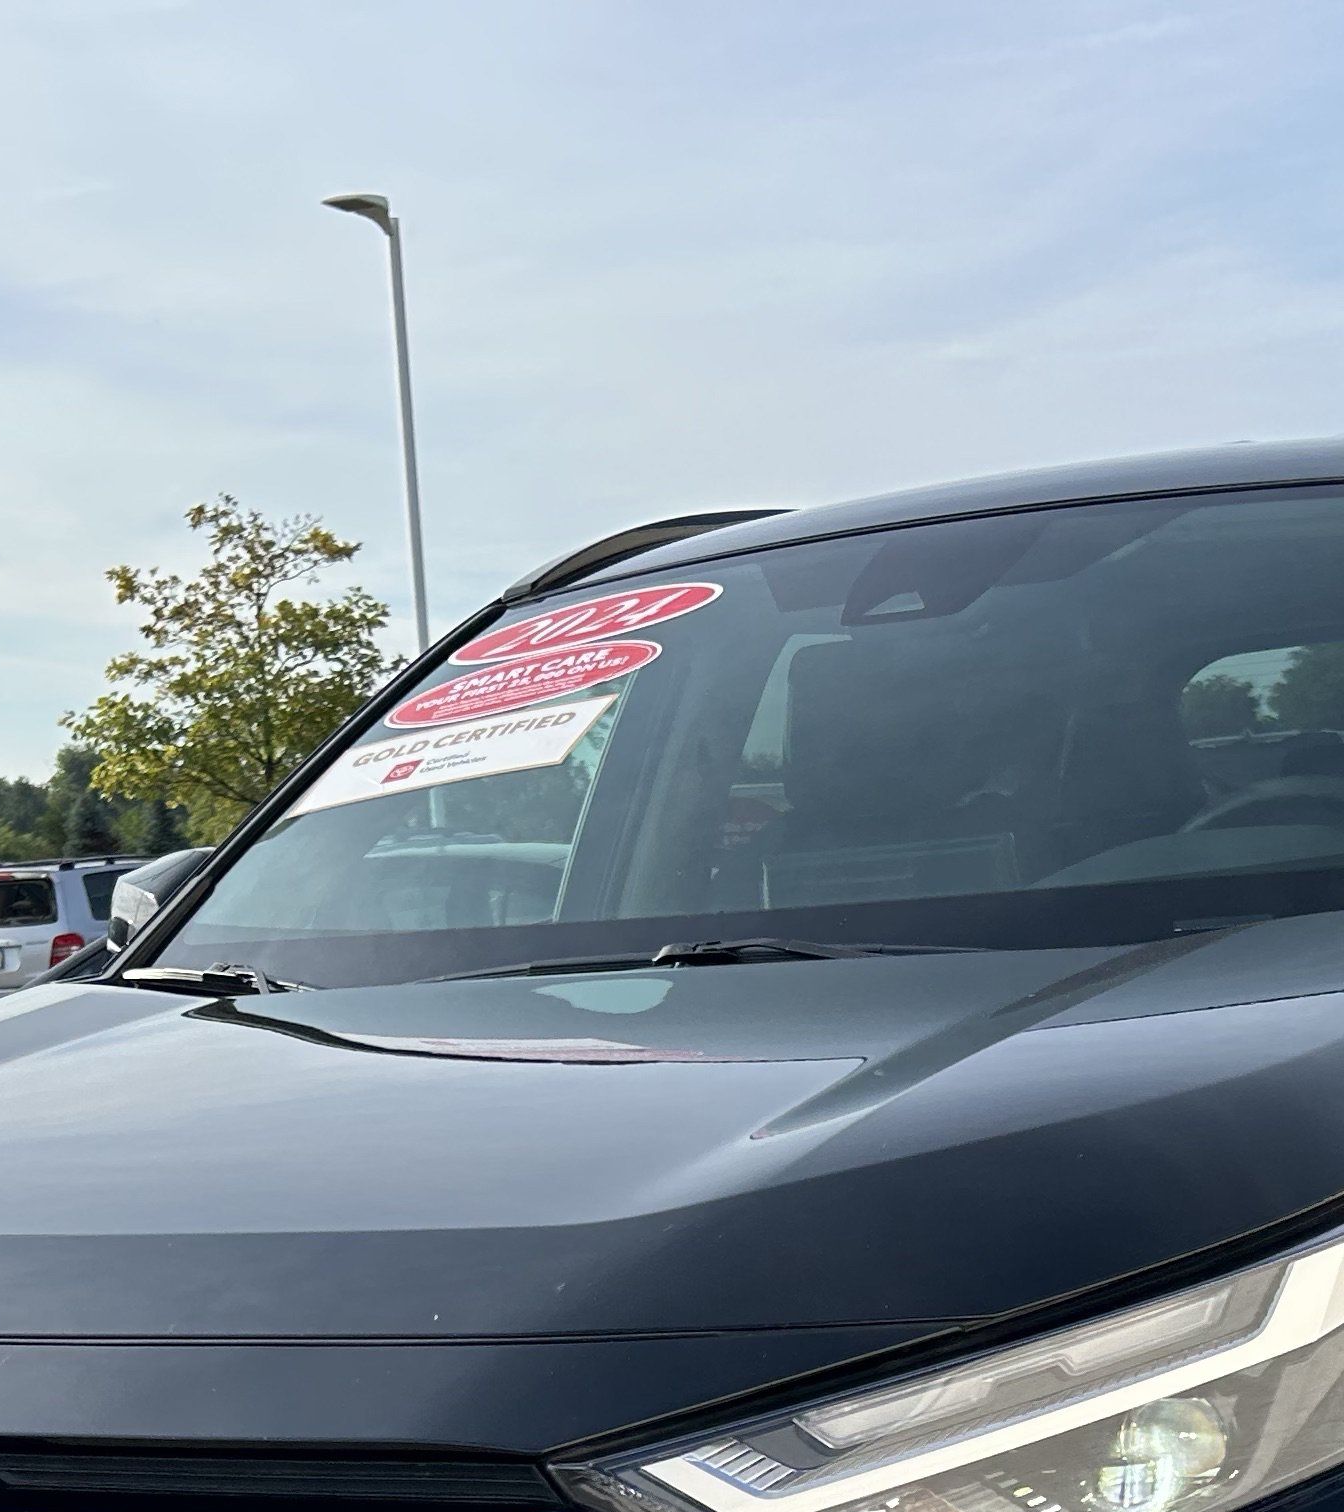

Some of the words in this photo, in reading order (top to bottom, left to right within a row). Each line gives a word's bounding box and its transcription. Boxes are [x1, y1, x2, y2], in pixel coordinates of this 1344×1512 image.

[479, 587, 692, 658] 2024
[416, 692, 461, 711] YOUR
[461, 681, 508, 699] FIRST
[567, 662, 597, 675] ON
[597, 656, 630, 669] US!
[448, 663, 542, 694] SMART
[541, 647, 614, 672] CARE
[352, 739, 431, 768] GOLD
[432, 711, 577, 749] CERTIFIED
